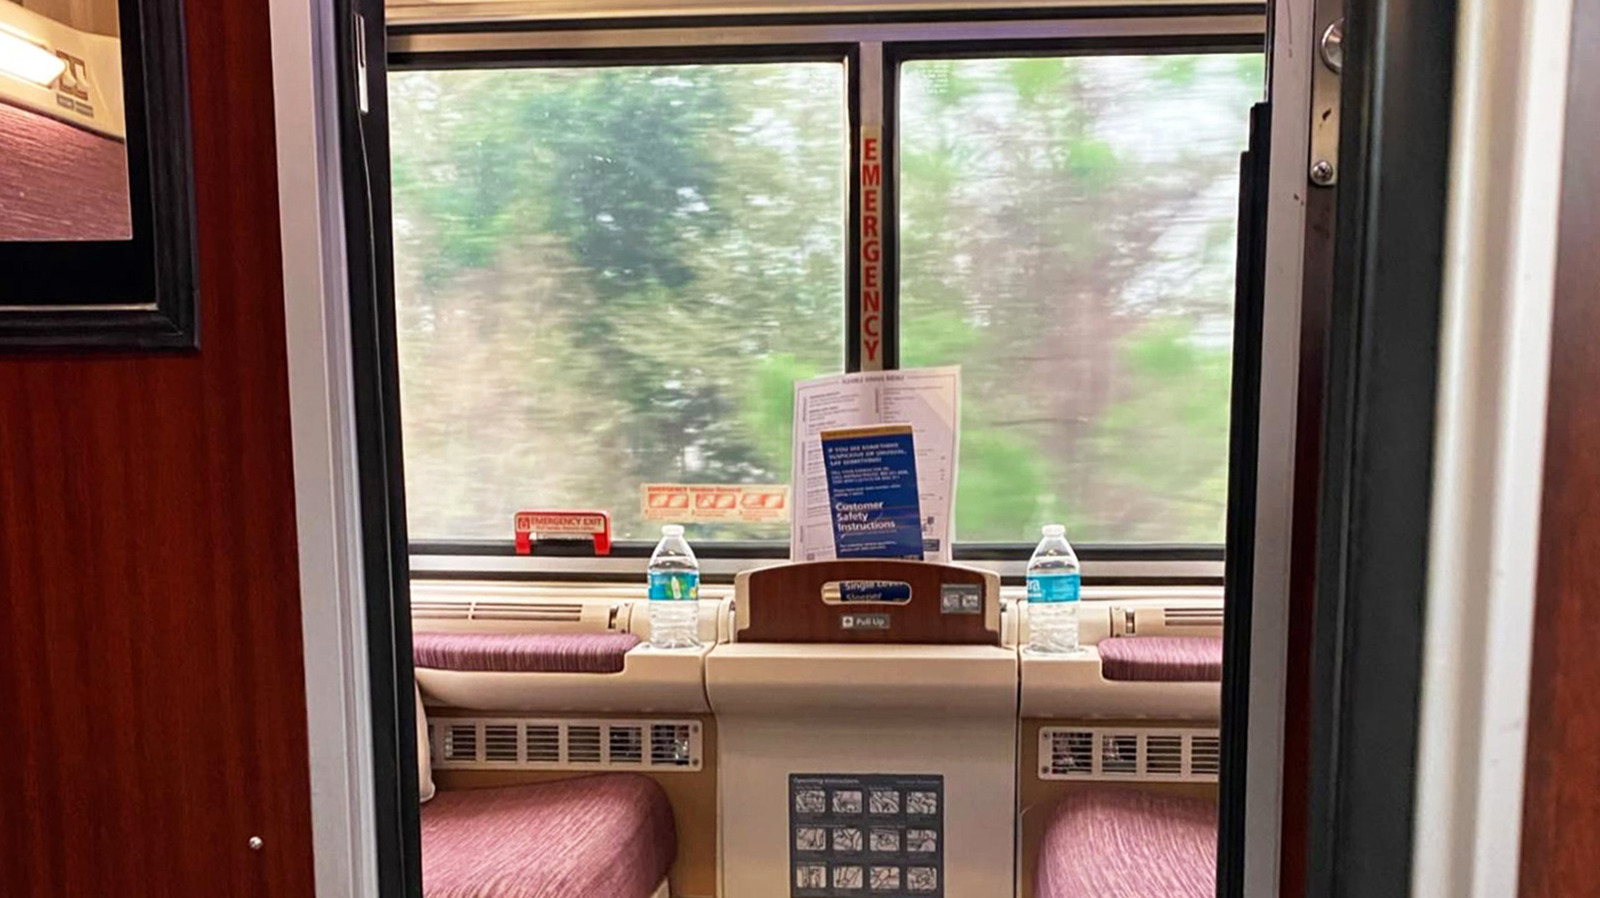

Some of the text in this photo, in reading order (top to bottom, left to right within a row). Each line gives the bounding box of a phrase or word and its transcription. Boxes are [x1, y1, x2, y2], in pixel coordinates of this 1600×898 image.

[862, 138, 880, 361] EMERGENCY
[836, 501, 884, 512] Customer
[531, 517, 602, 526] EMERGENCY EXIT
[836, 512, 868, 522] Safety
[838, 521, 896, 532] Instructions
[856, 617, 885, 627] Pull Up
